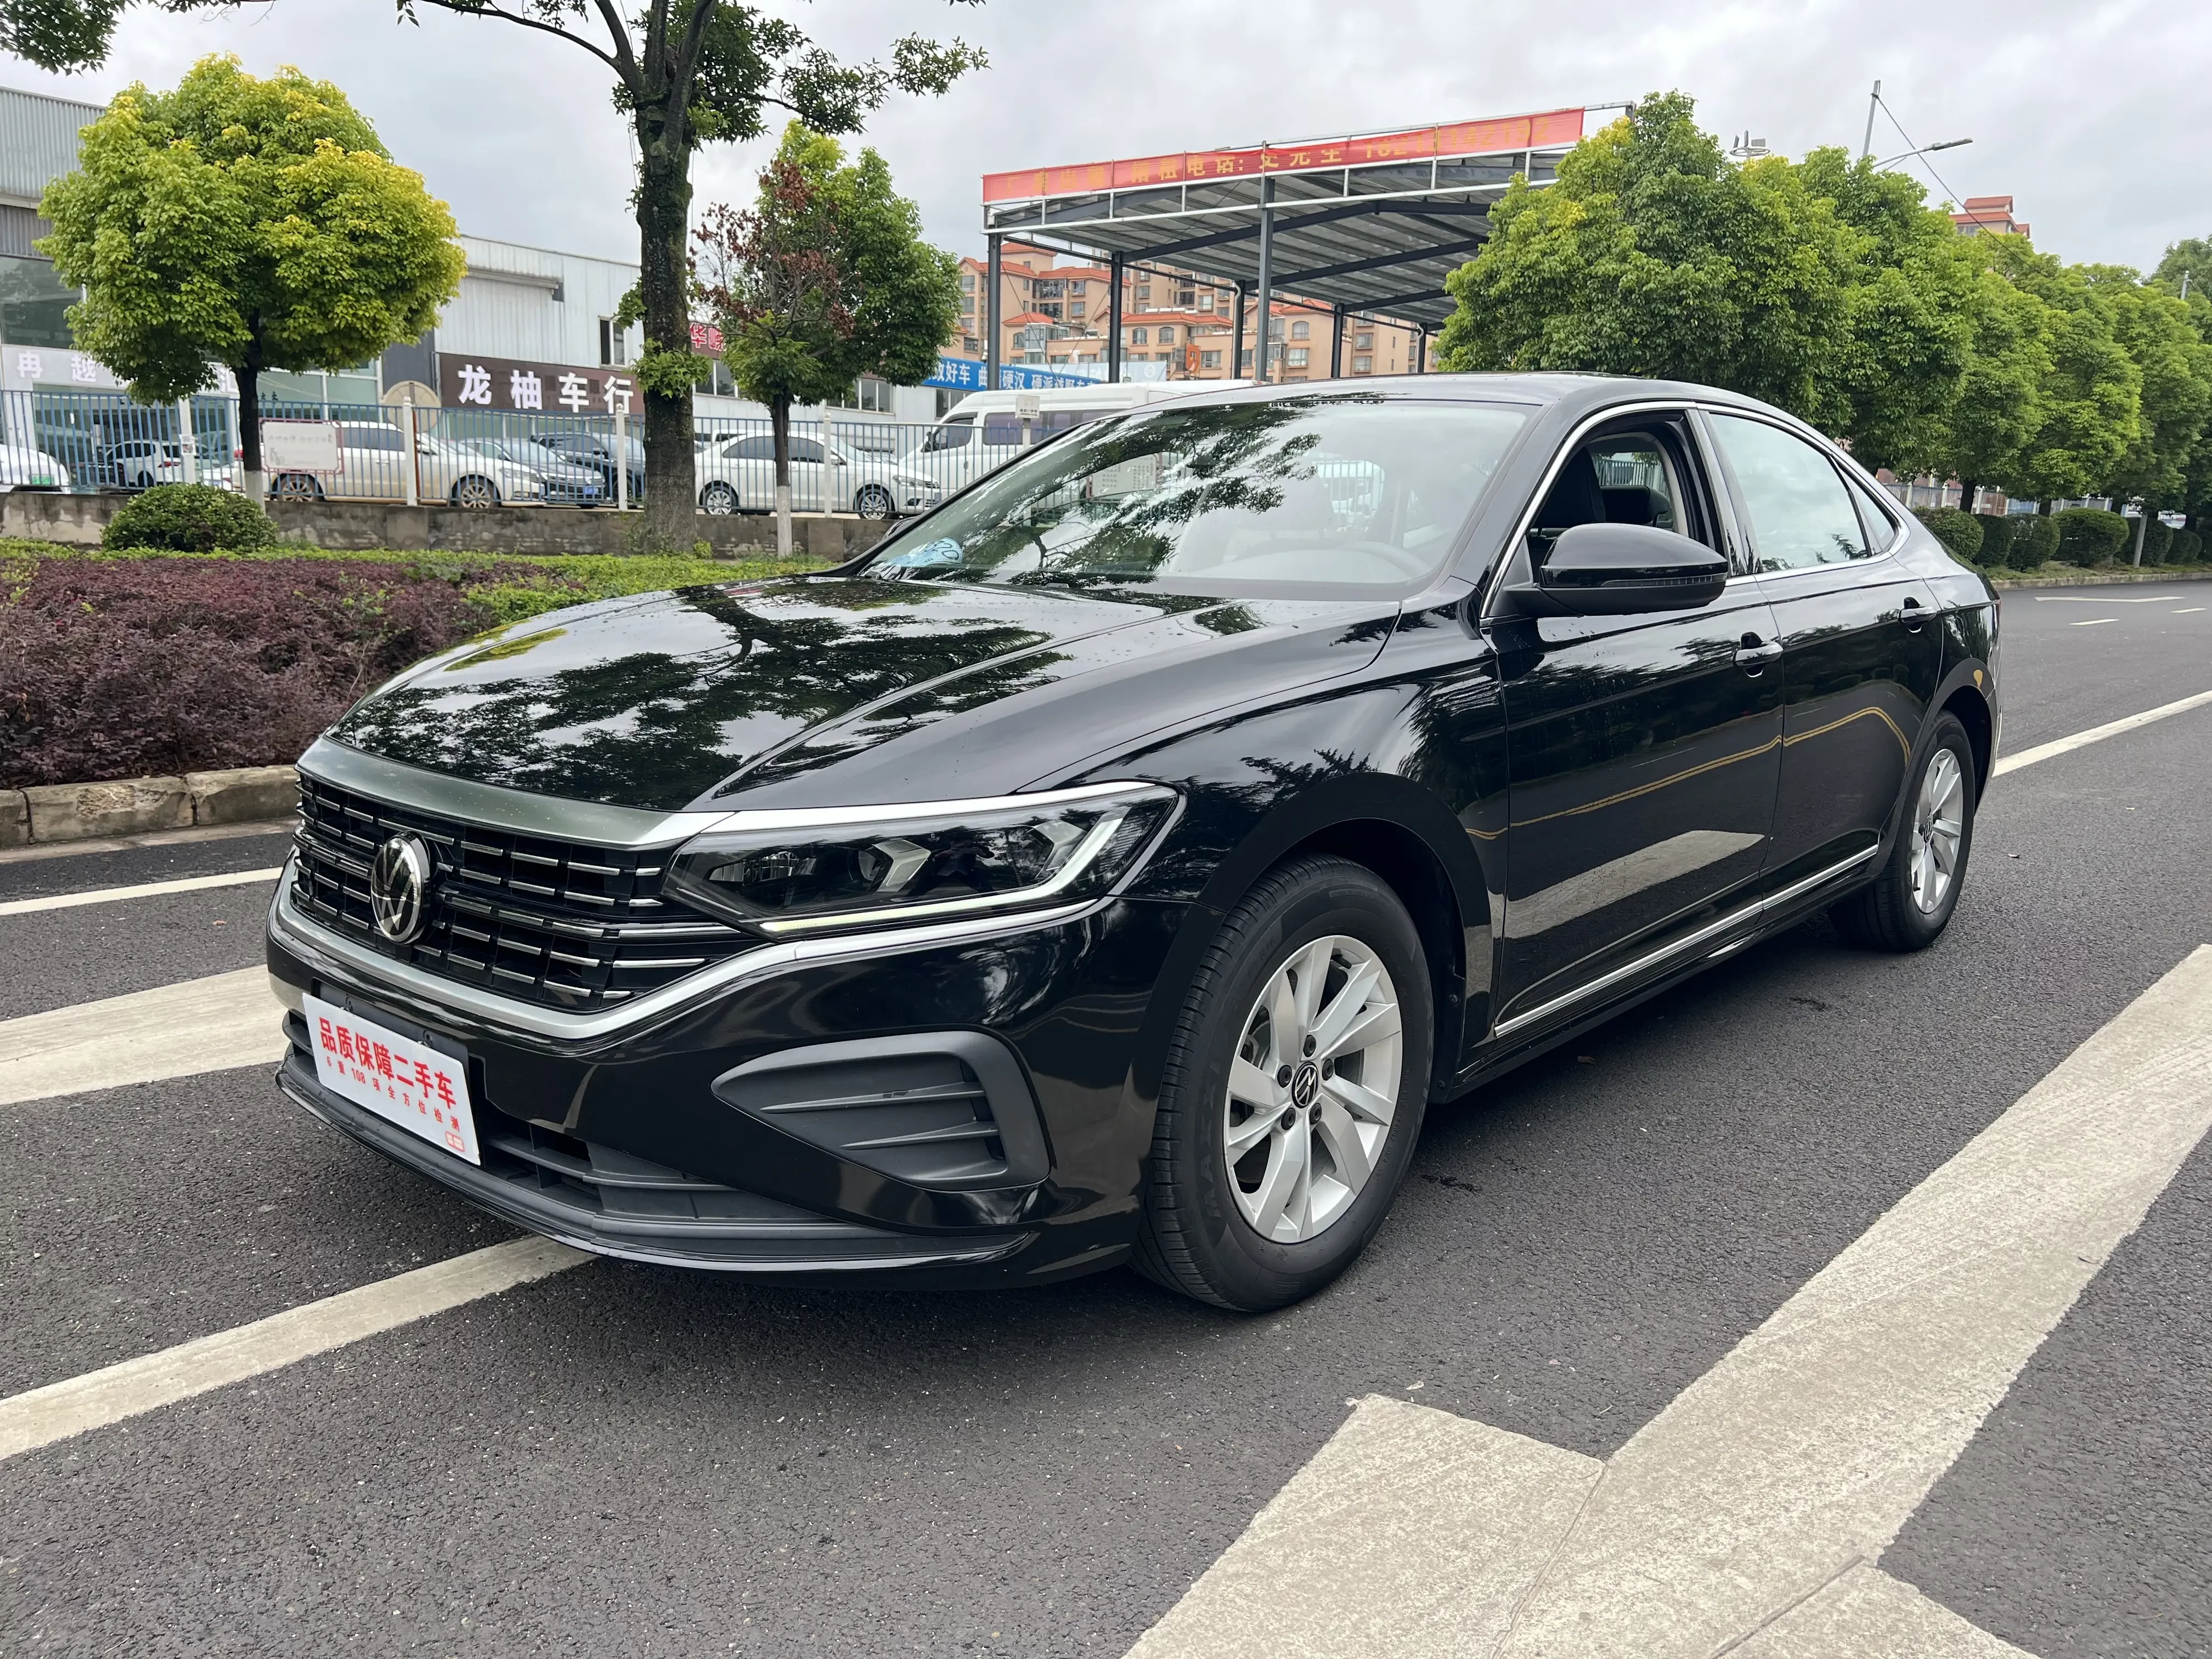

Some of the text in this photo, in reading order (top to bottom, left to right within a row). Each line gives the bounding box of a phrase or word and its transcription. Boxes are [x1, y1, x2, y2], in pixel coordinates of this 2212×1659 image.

[458, 364, 634, 414] 龙柚车行
[978, 366, 1025, 390] 曲硬汉
[319, 1017, 456, 1109] 品质保障二手车
